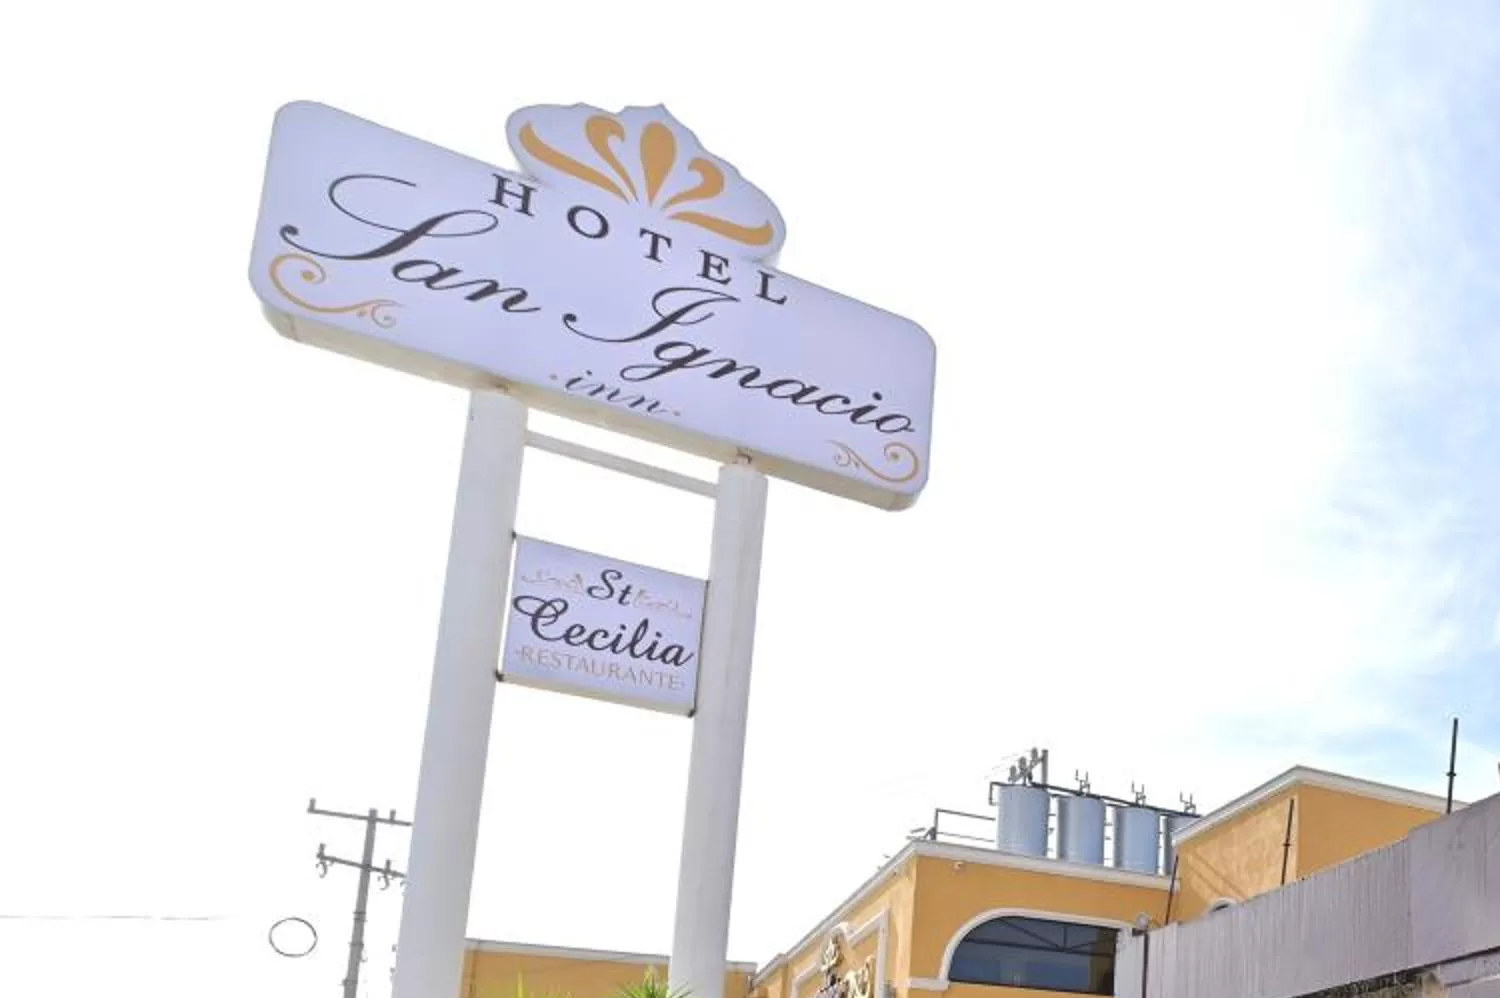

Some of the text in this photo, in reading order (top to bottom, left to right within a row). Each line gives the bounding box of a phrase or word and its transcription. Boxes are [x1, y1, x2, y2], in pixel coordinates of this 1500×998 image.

[487, 173, 788, 307] HOTEL
[280, 174, 915, 434] San Ignacio
[587, 569, 632, 606] St
[513, 595, 695, 667] Cecilia
[519, 645, 682, 690] RESTAURANTE
